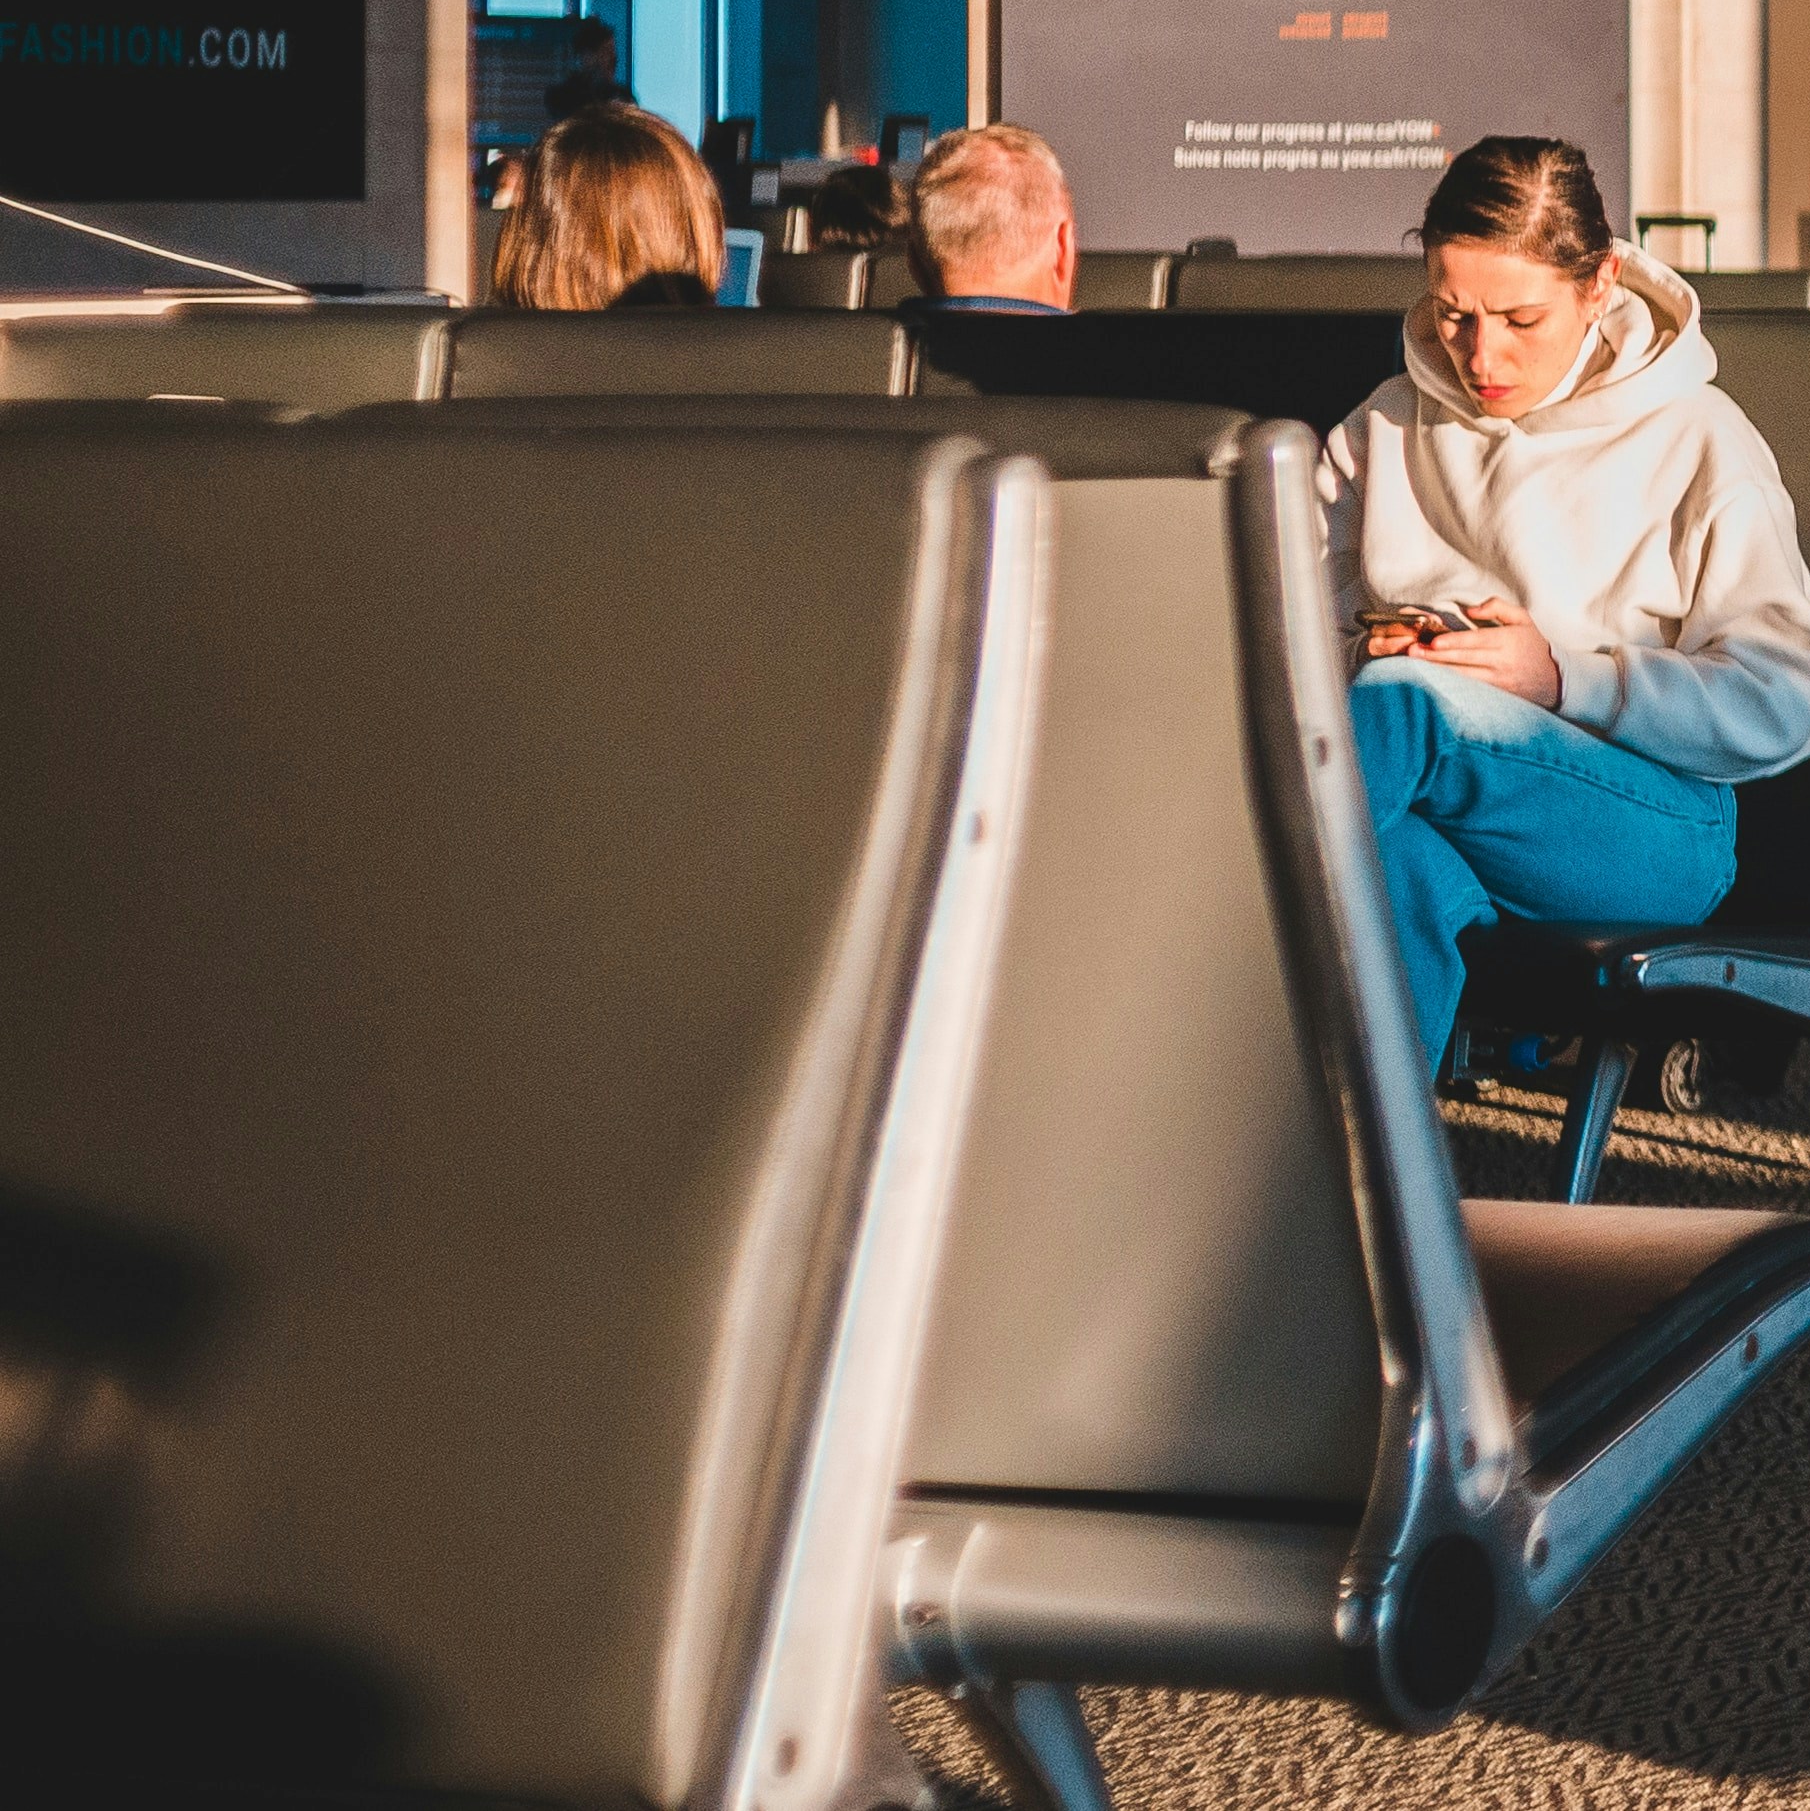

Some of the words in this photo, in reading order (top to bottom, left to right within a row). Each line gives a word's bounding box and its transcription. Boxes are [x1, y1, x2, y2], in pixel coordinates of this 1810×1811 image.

[0, 20, 288, 71] FASHION.COM
[1185, 120, 1232, 142] Follow
[1234, 123, 1260, 142] our
[1262, 123, 1325, 145] progress
[1327, 121, 1342, 142] at
[1174, 146, 1221, 169] Suivez
[1223, 147, 1260, 169] notre
[1320, 149, 1339, 169] au
